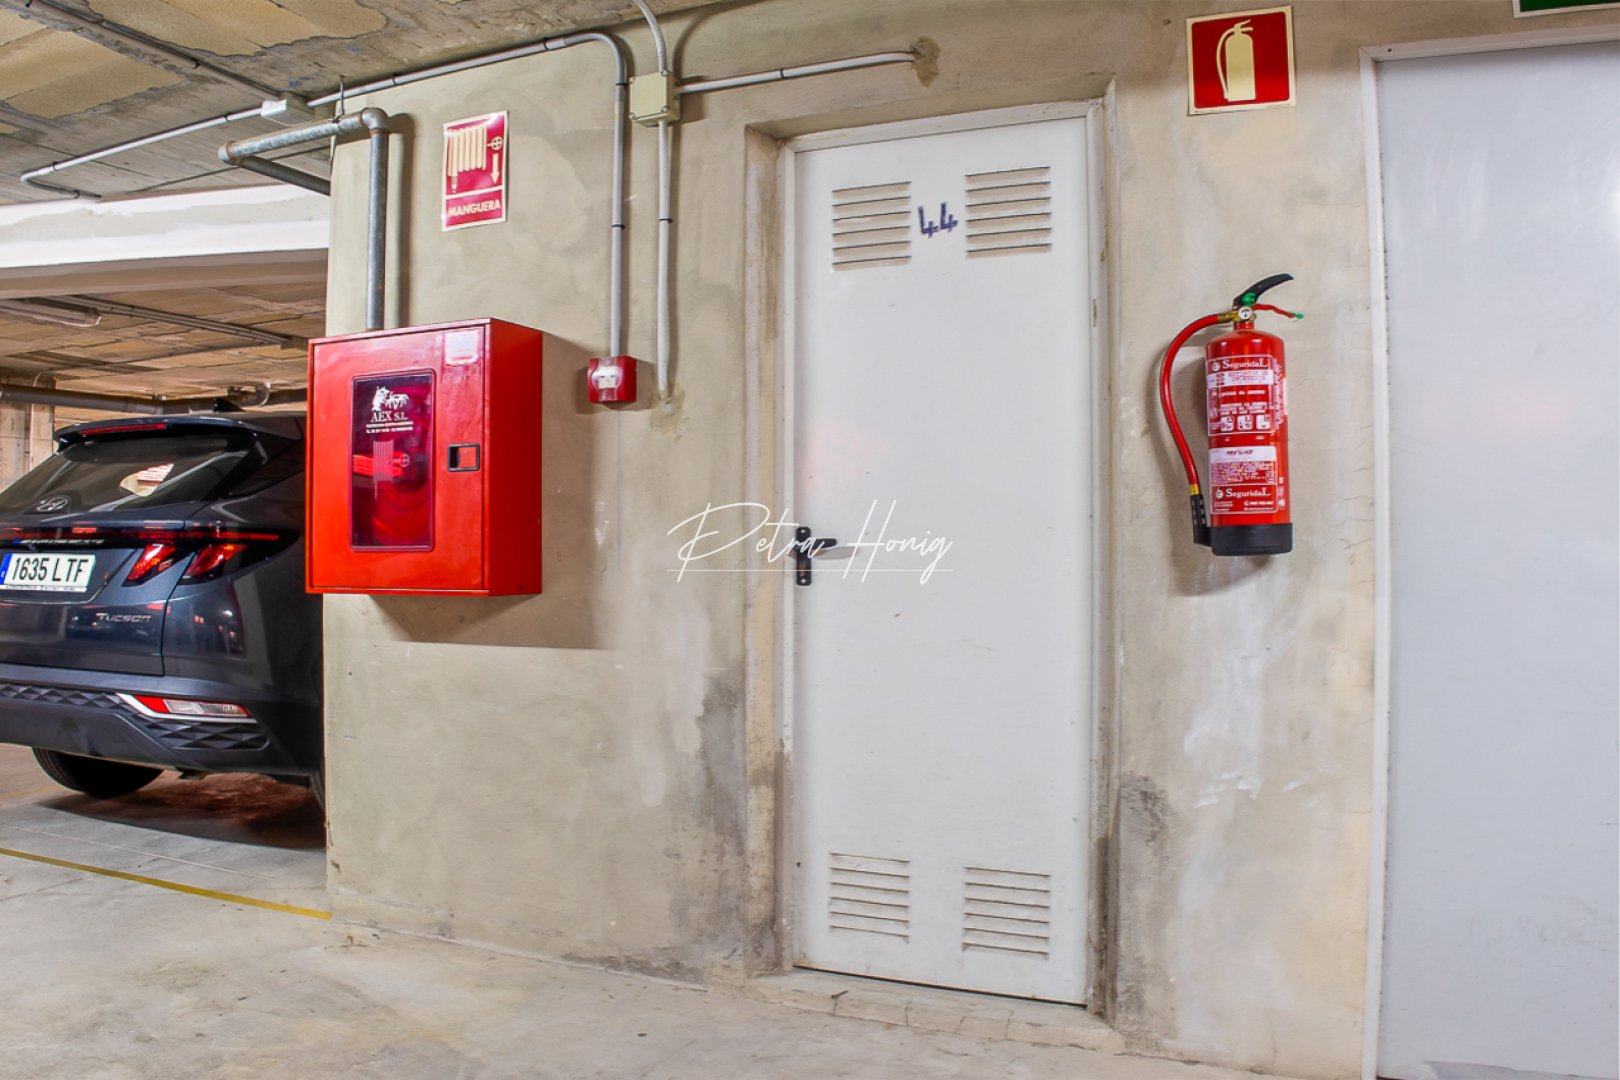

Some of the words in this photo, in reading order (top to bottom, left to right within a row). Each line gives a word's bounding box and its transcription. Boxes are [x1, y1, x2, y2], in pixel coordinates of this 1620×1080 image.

[448, 200, 500, 217] MANGUERA
[918, 202, 958, 238] 44
[371, 411, 392, 422] AEX
[12, 557, 50, 581] 1635
[52, 558, 89, 582] LTF
